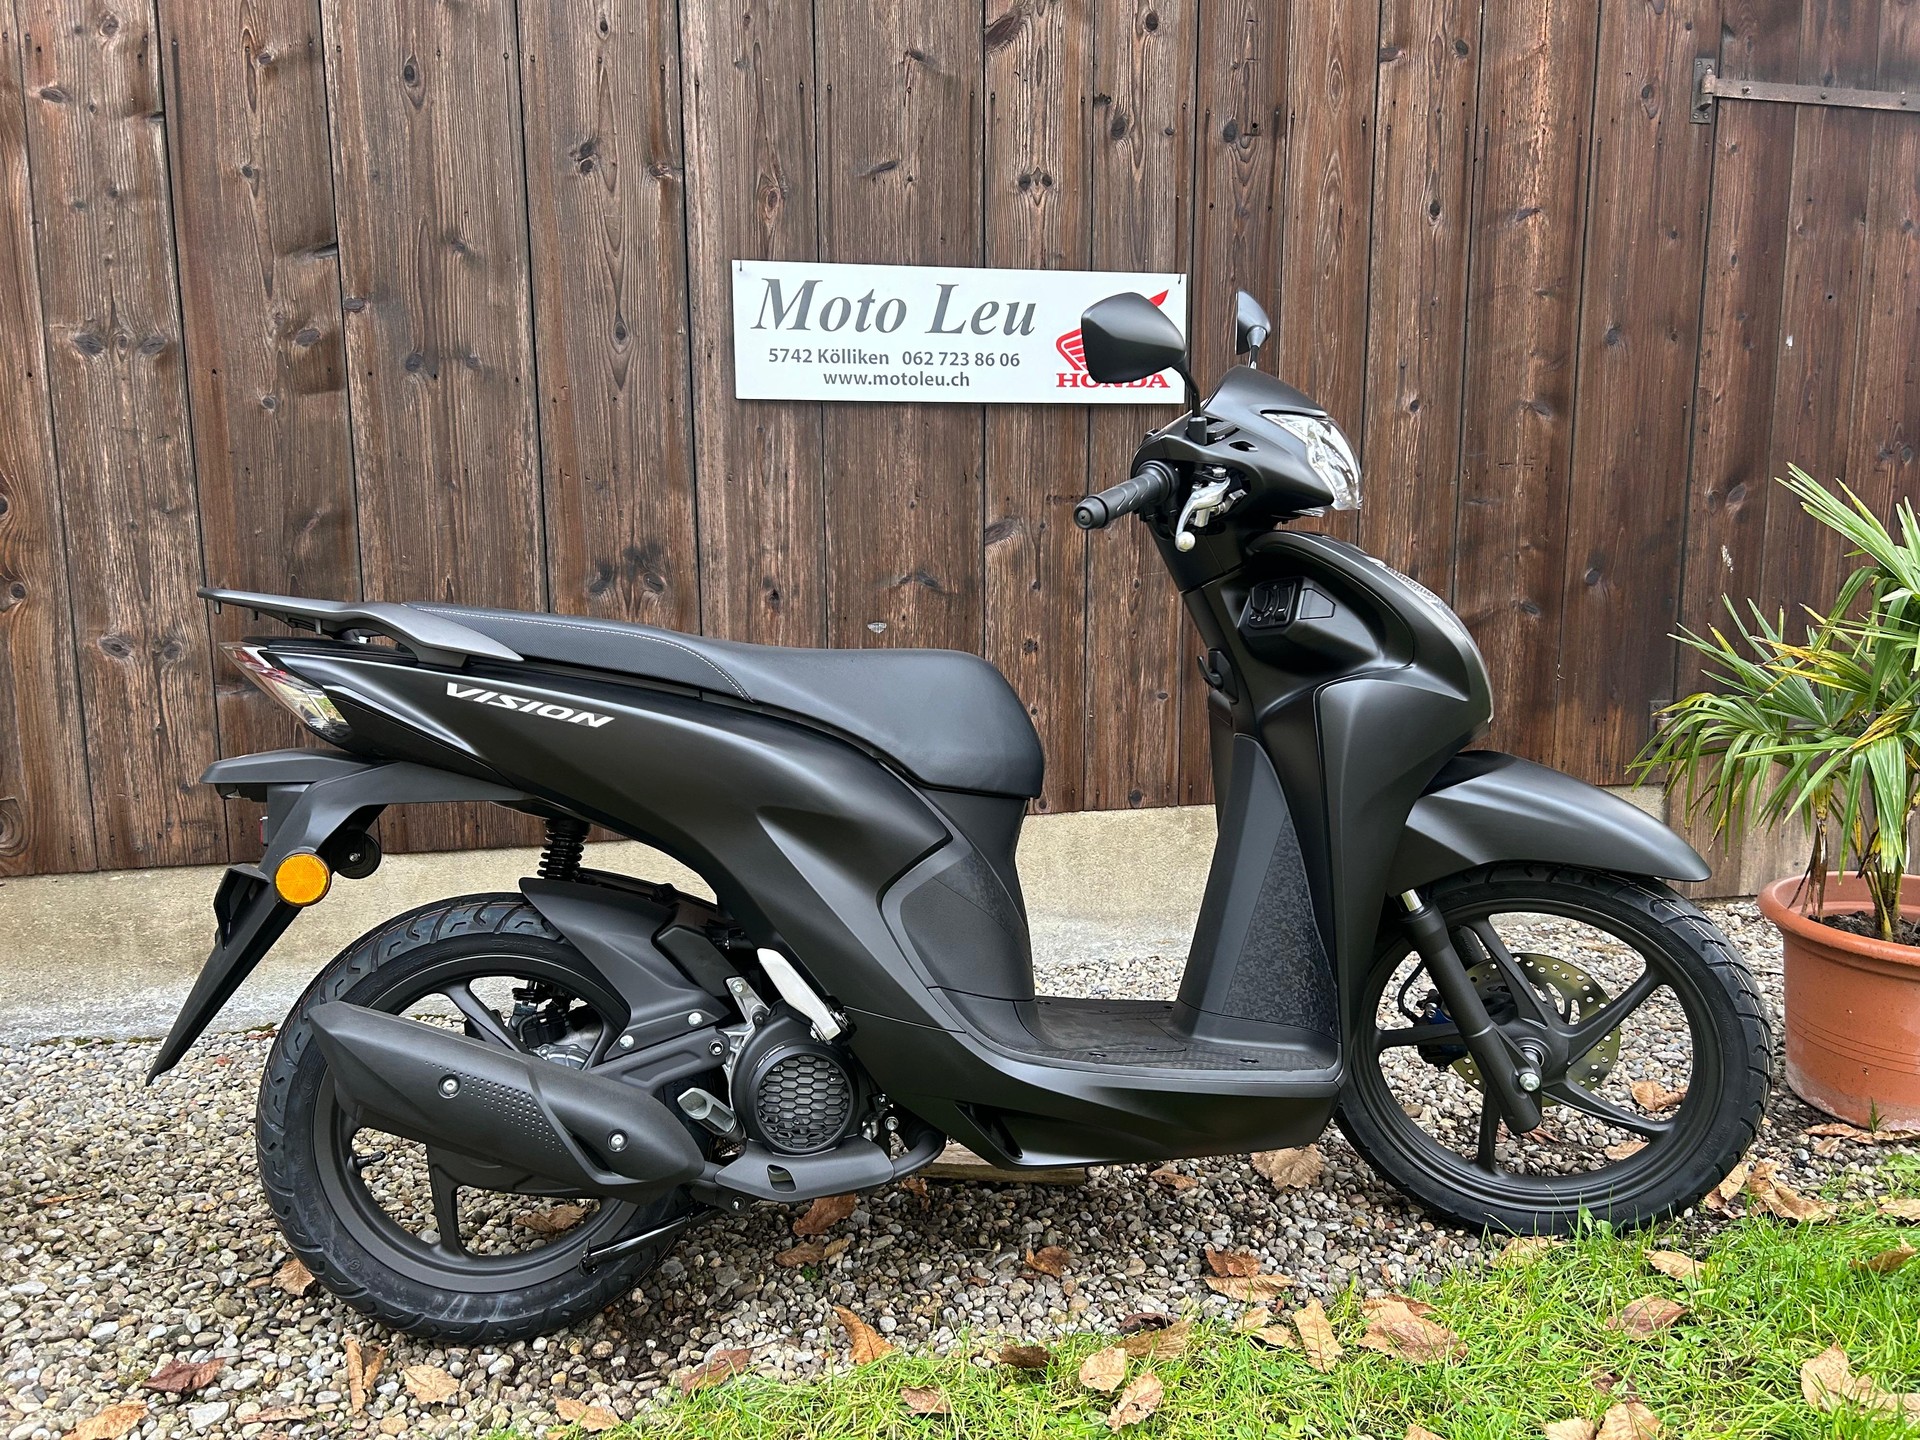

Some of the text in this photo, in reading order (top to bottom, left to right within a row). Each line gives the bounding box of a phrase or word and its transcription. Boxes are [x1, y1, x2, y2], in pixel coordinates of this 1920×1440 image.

[750, 278, 1037, 336] Moto Leu
[768, 348, 1021, 367] 5742 Kölliken 062 723 86 06
[823, 371, 970, 387] www.motoleu.ch
[447, 682, 615, 728] VISION
